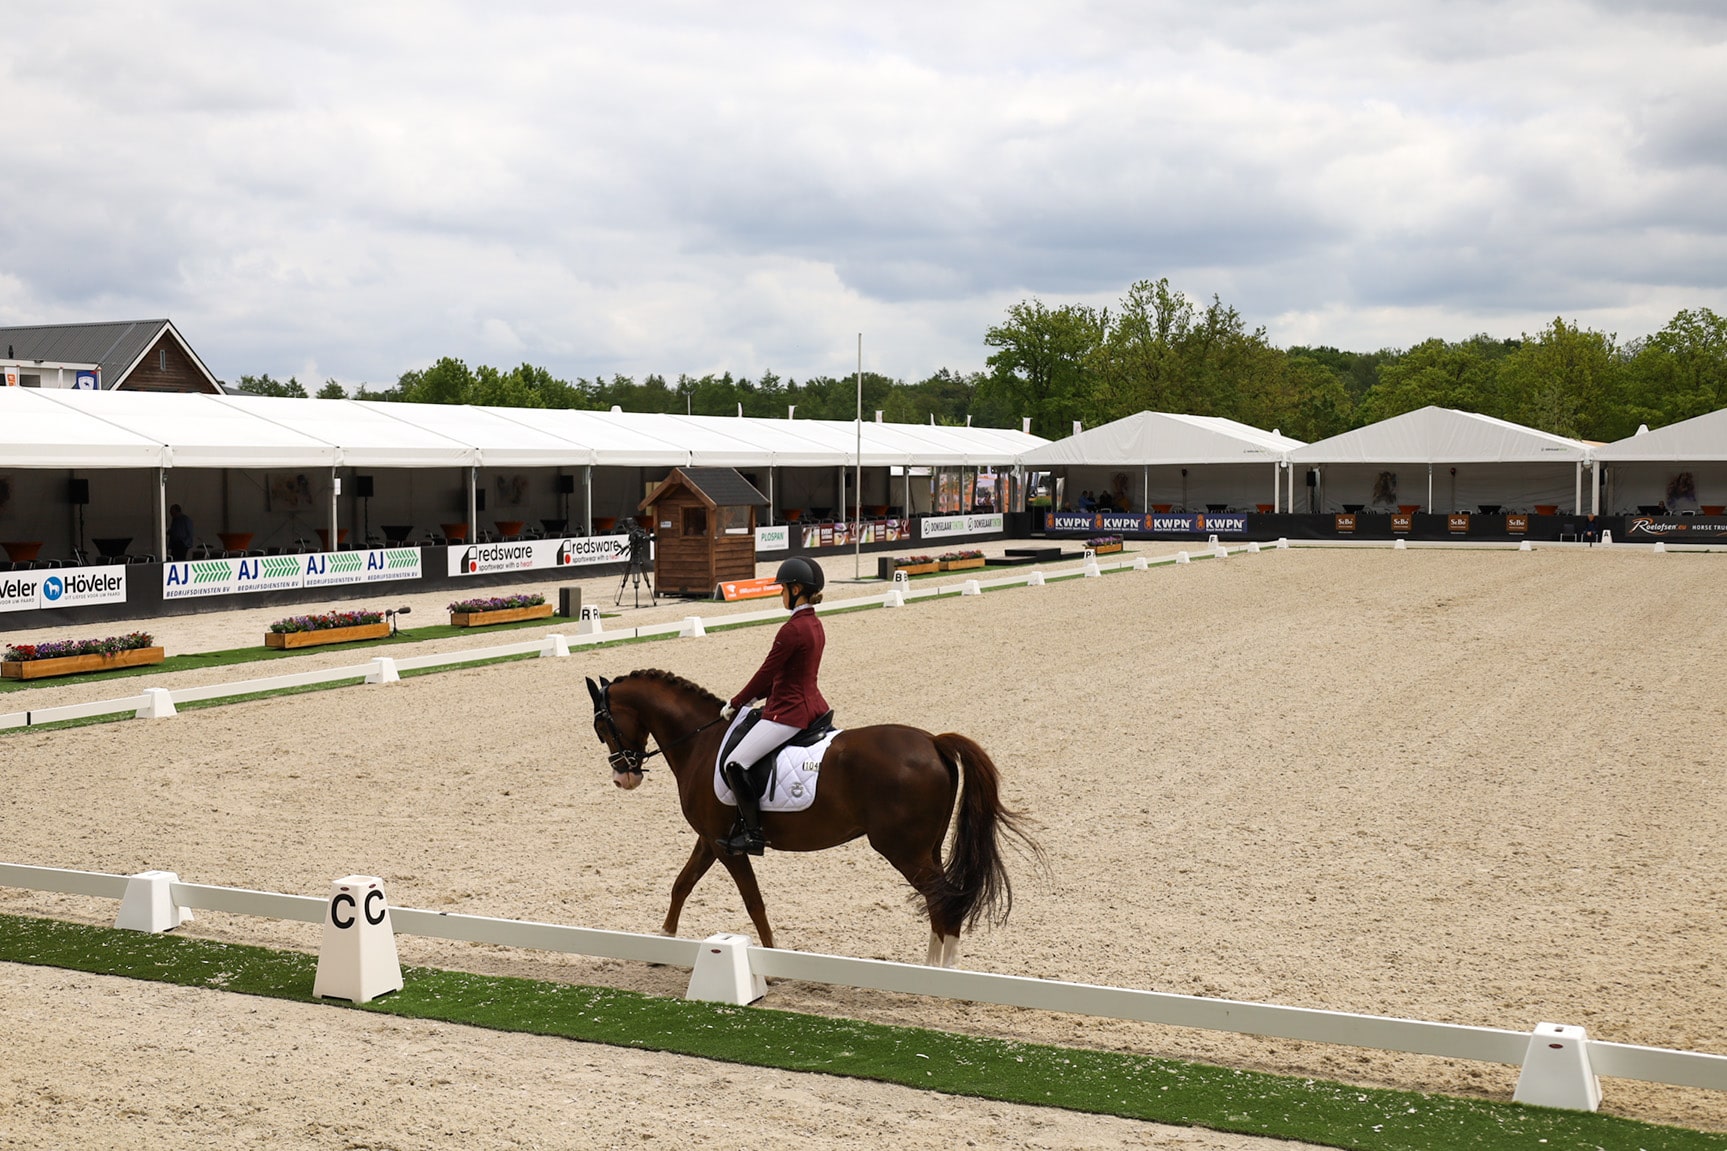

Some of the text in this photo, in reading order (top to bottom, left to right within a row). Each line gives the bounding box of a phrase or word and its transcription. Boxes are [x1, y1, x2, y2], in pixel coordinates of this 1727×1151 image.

[1056, 518, 1090, 527] KWPN
[1104, 518, 1139, 528] KWPN
[1154, 518, 1191, 528] KWPN
[1206, 519, 1243, 528] KWPN
[761, 532, 784, 542] PLOSPAN
[572, 538, 620, 554] redsware
[478, 544, 533, 562] redsware
[306, 555, 325, 575] AJ
[368, 551, 384, 570] AJ
[166, 564, 189, 586] AJ
[238, 559, 259, 580] AJ
[896, 573, 902, 582] B
[238, 582, 290, 591] BEDRIJFSDIENSTEN
[166, 588, 221, 597] BEDRIJFSDIENSTEN
[582, 609, 590, 620] R
[593, 609, 599, 620] R
[331, 893, 356, 929] C
[364, 890, 385, 925] C
